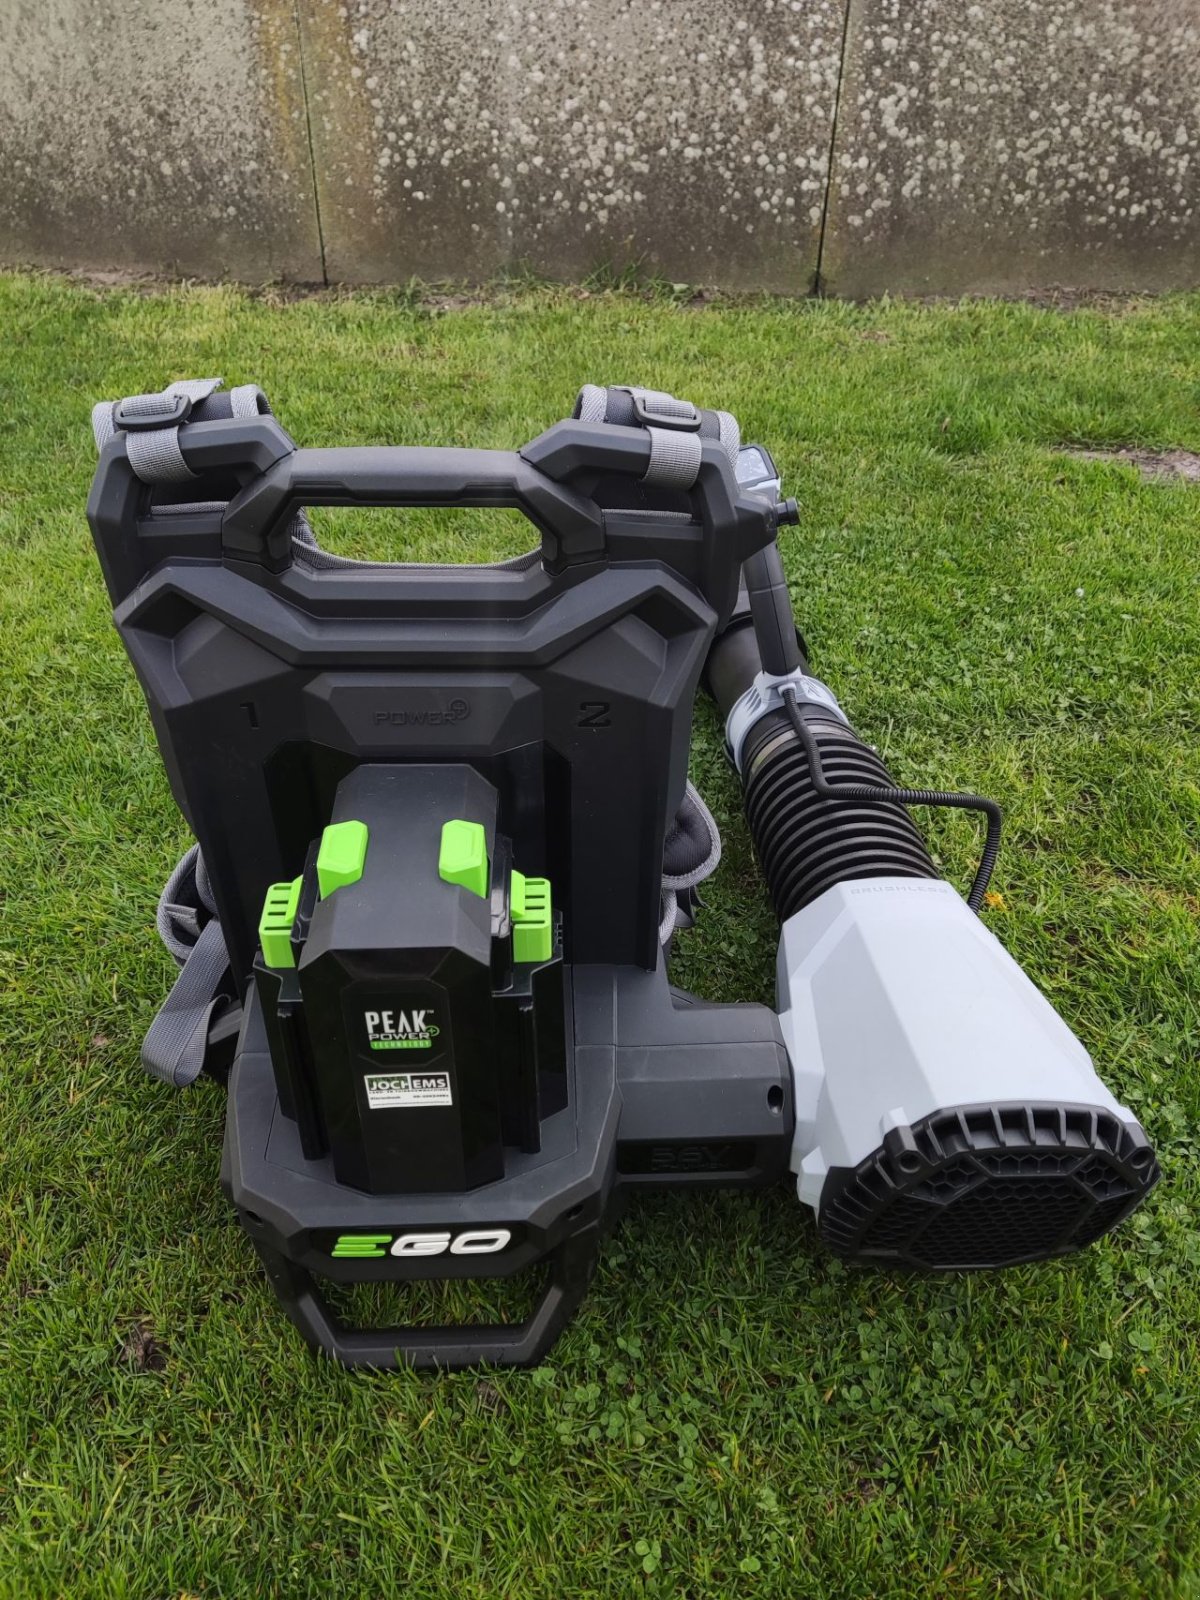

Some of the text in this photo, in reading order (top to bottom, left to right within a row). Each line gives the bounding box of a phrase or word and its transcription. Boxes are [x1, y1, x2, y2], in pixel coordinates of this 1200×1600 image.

[240, 701, 259, 728] 1
[373, 710, 457, 726] POWER
[577, 701, 612, 728] 2
[850, 885, 949, 895] BRUSHLESS
[368, 1033, 431, 1042] POWER
[373, 1040, 430, 1050] TECHNOLOGY
[370, 1078, 447, 1091] JOCHEMS
[331, 1229, 512, 1258] EGO
